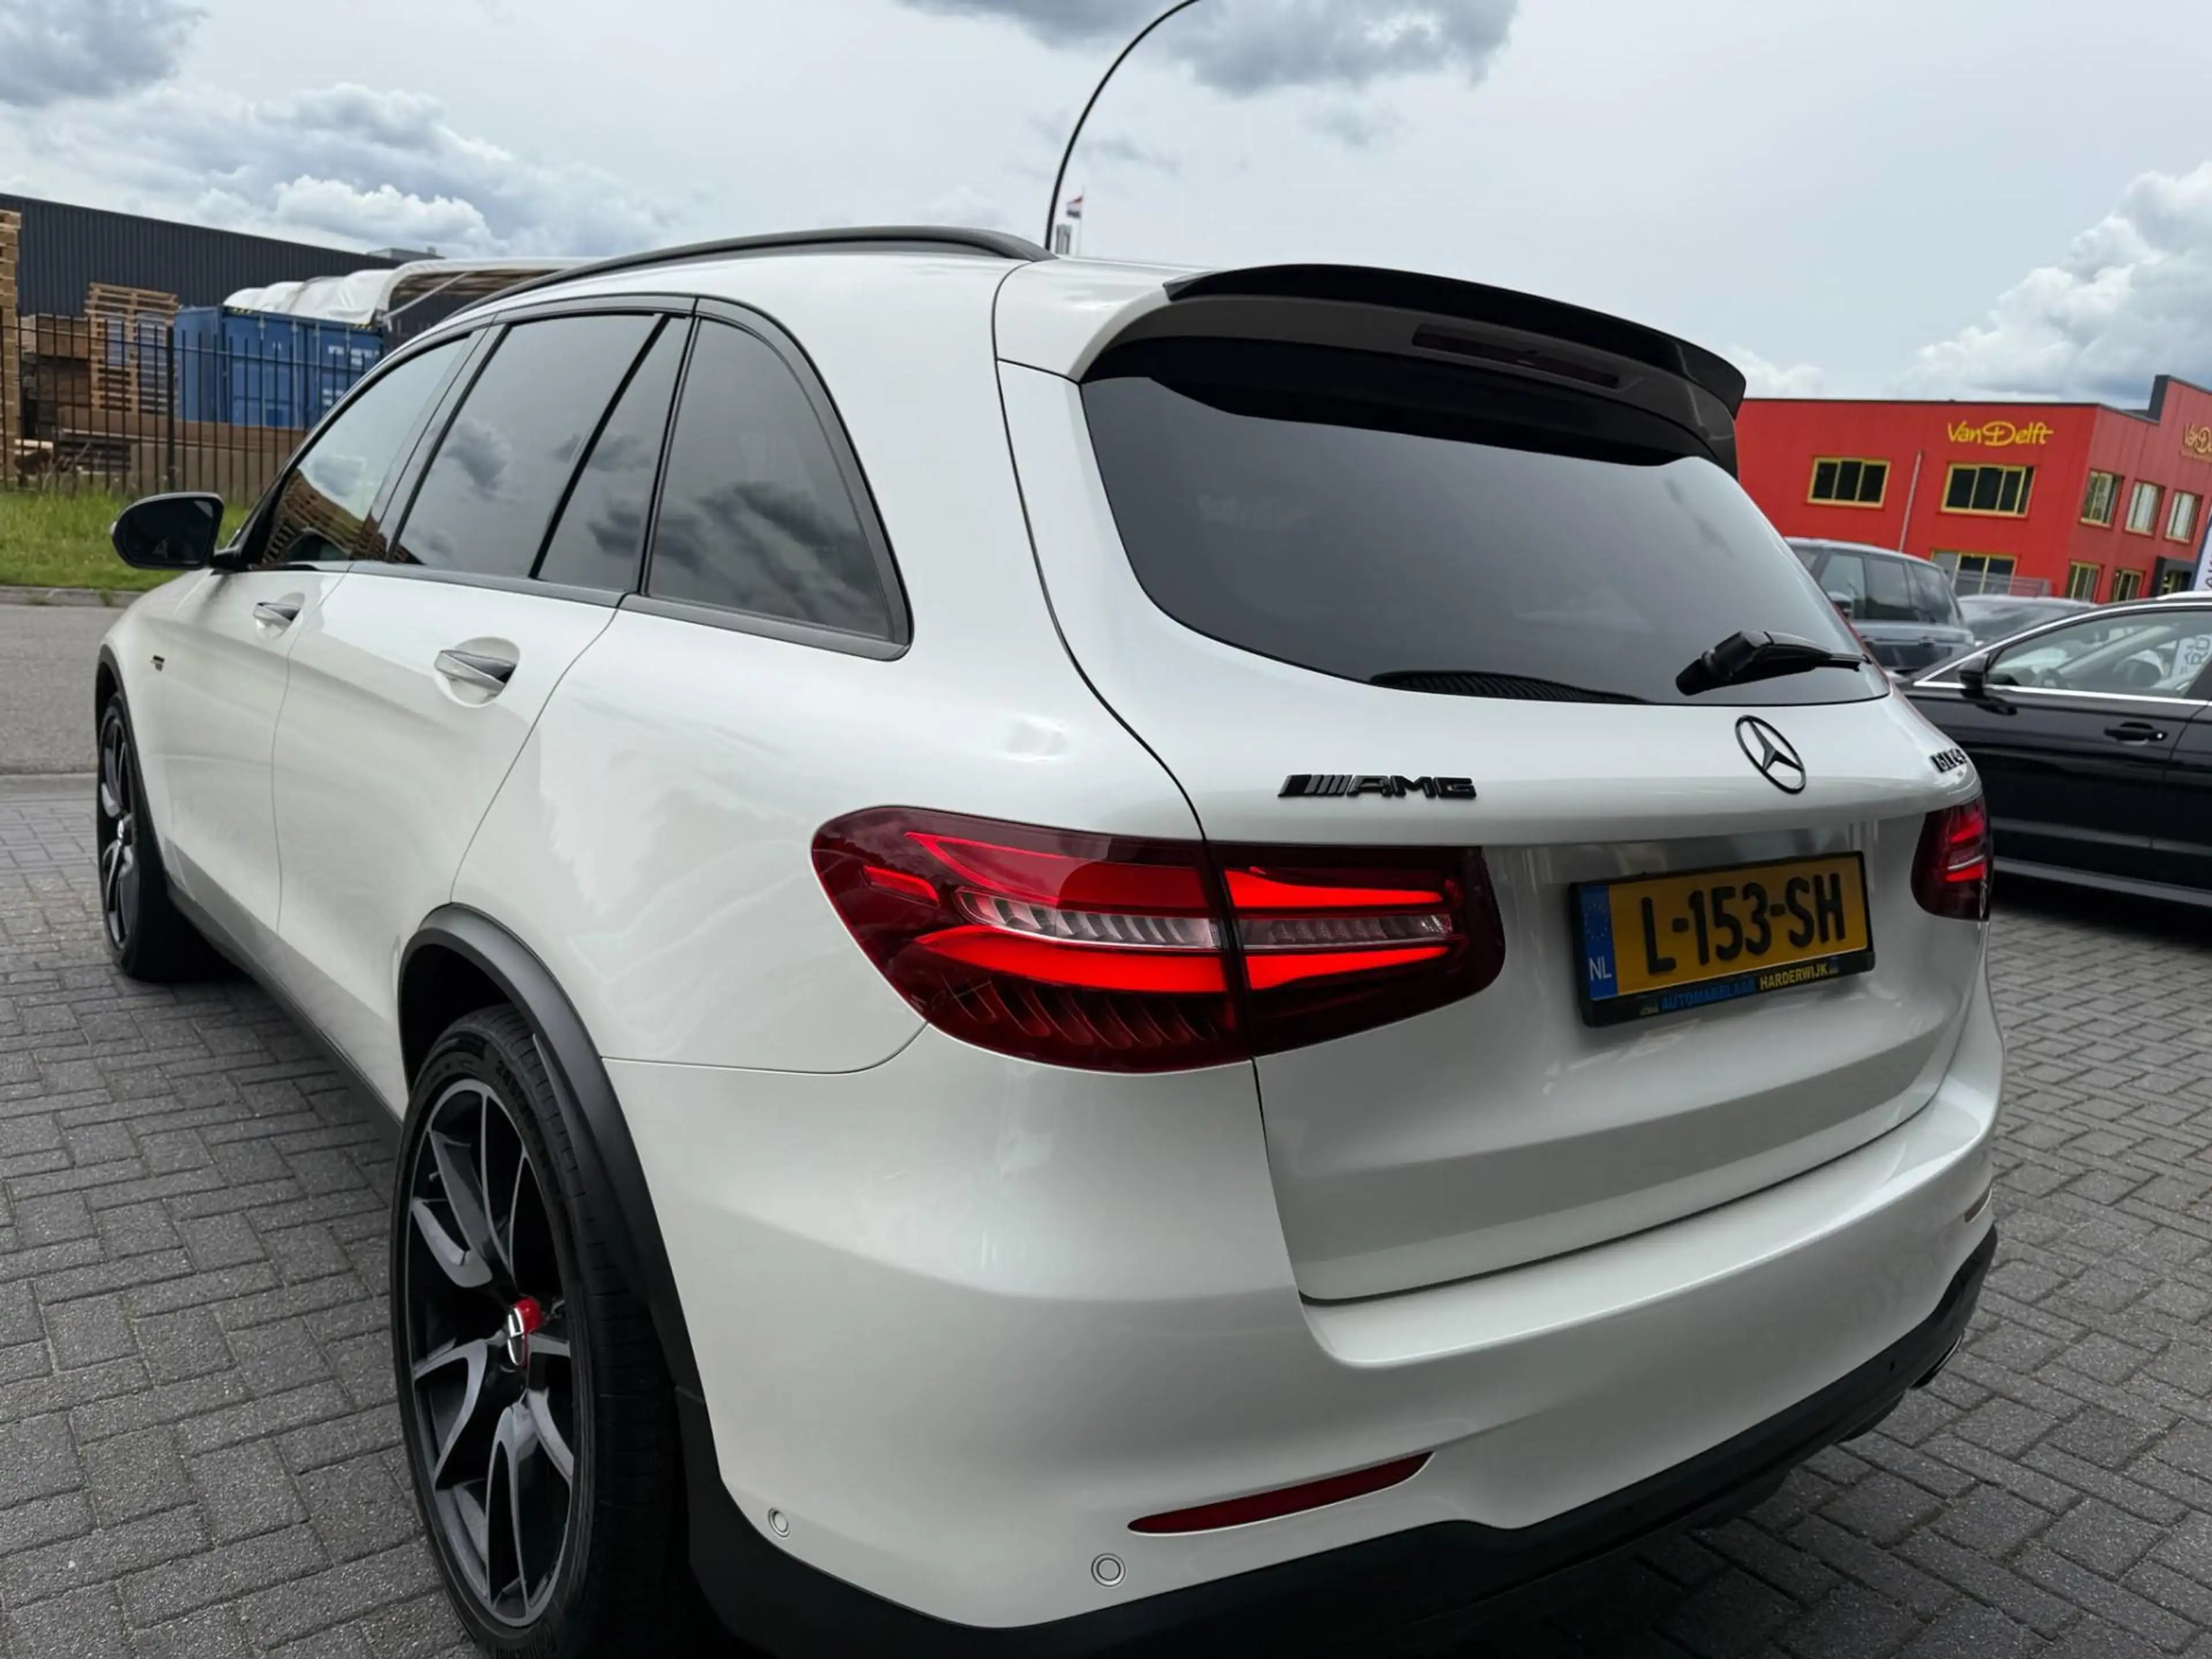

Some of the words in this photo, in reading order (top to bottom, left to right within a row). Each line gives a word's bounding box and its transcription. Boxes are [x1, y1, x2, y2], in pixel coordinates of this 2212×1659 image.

[1641, 873, 1846, 975] L-153-SH
[1588, 956, 1612, 981] NL
[1760, 963, 1830, 991] HARDERWIJK
